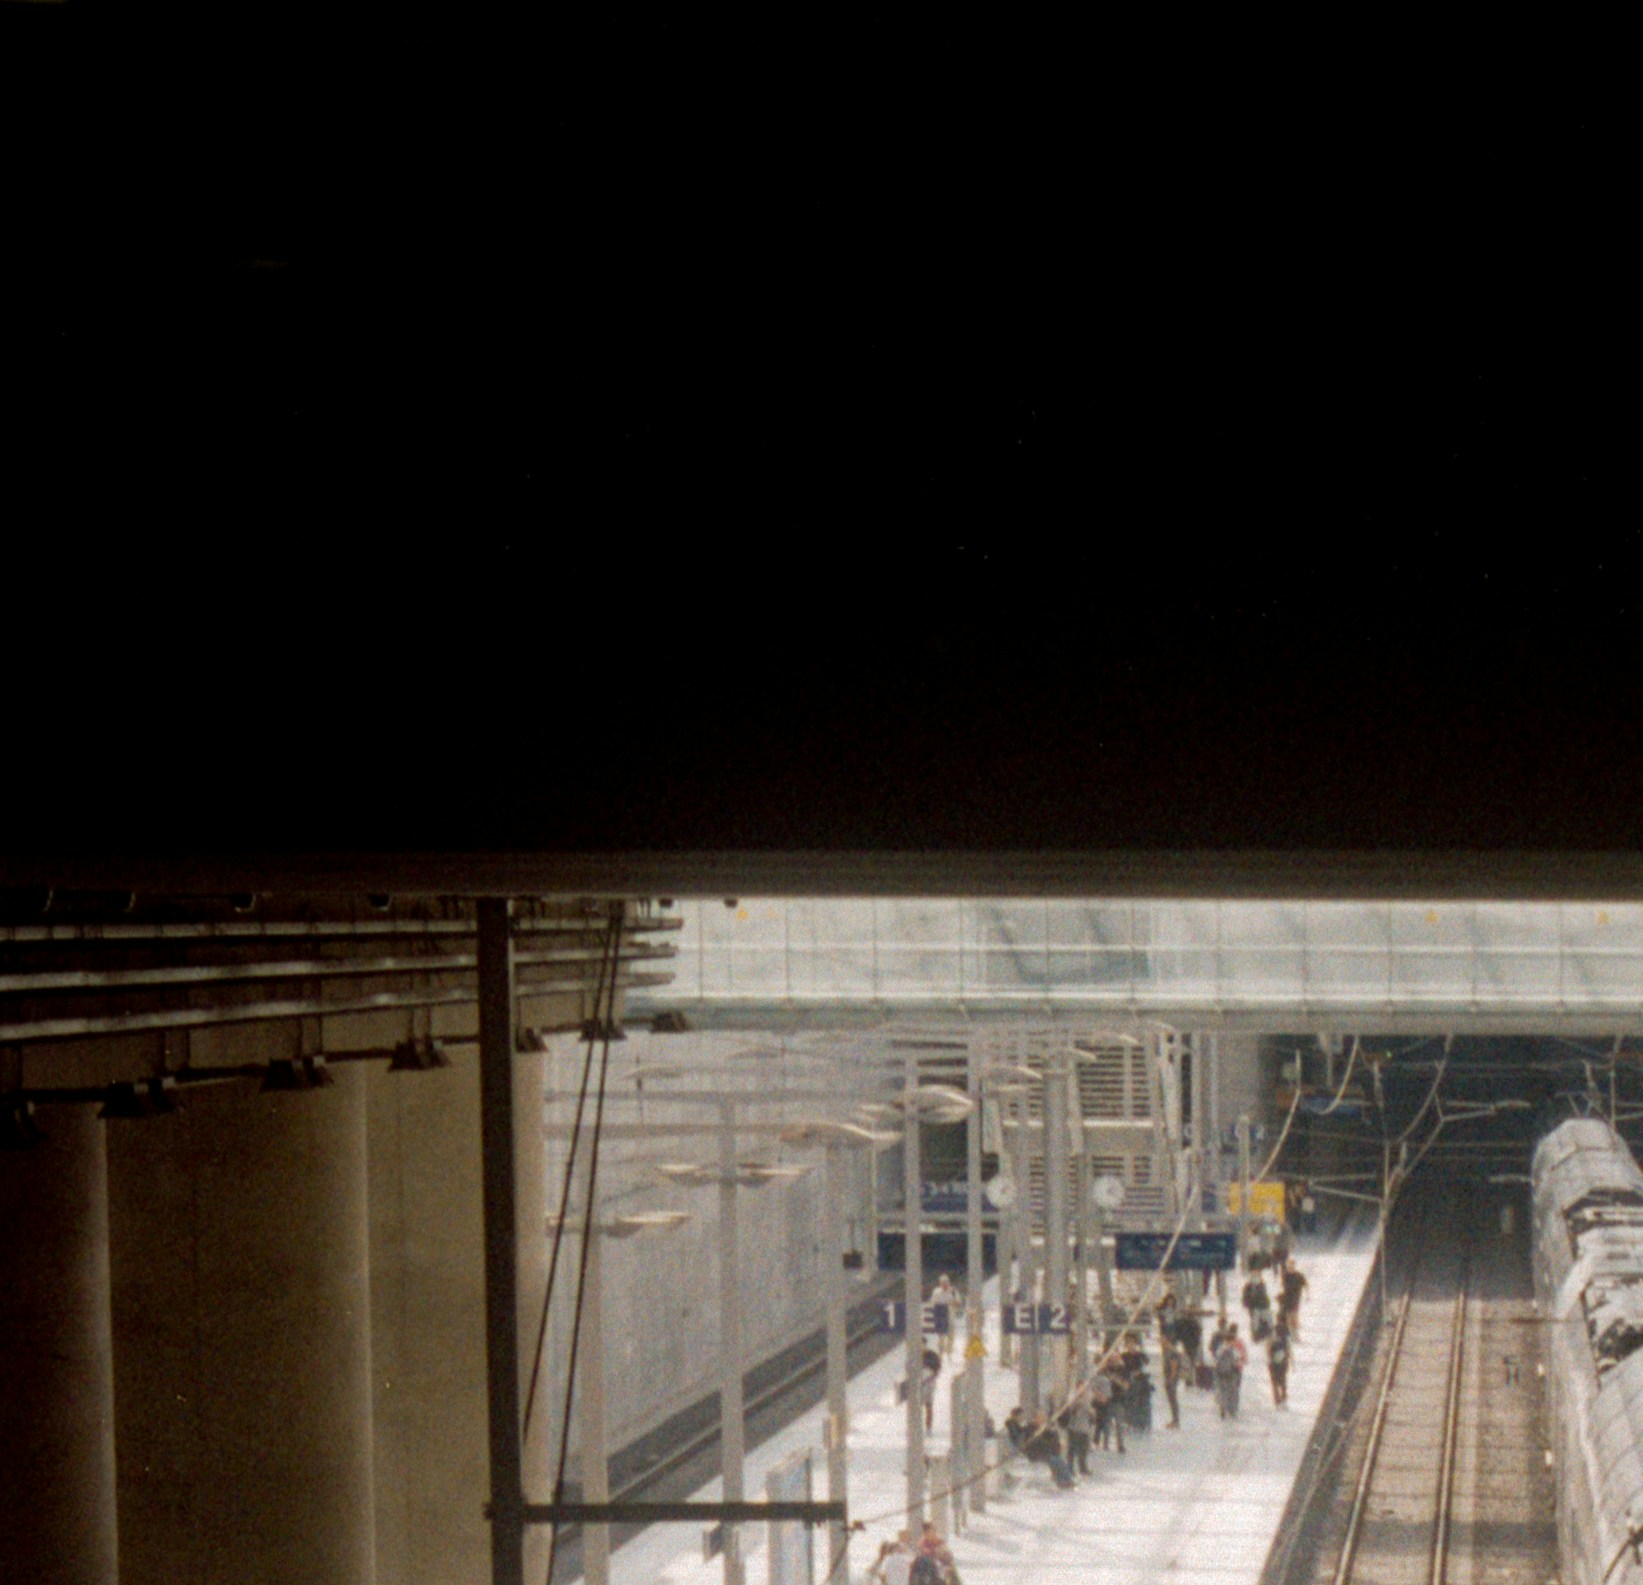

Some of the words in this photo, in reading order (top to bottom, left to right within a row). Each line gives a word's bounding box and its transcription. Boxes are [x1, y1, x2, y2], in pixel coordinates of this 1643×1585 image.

[883, 1303, 897, 1329] 1
[1014, 1303, 1031, 1329] E
[1050, 1303, 1066, 1330] 2
